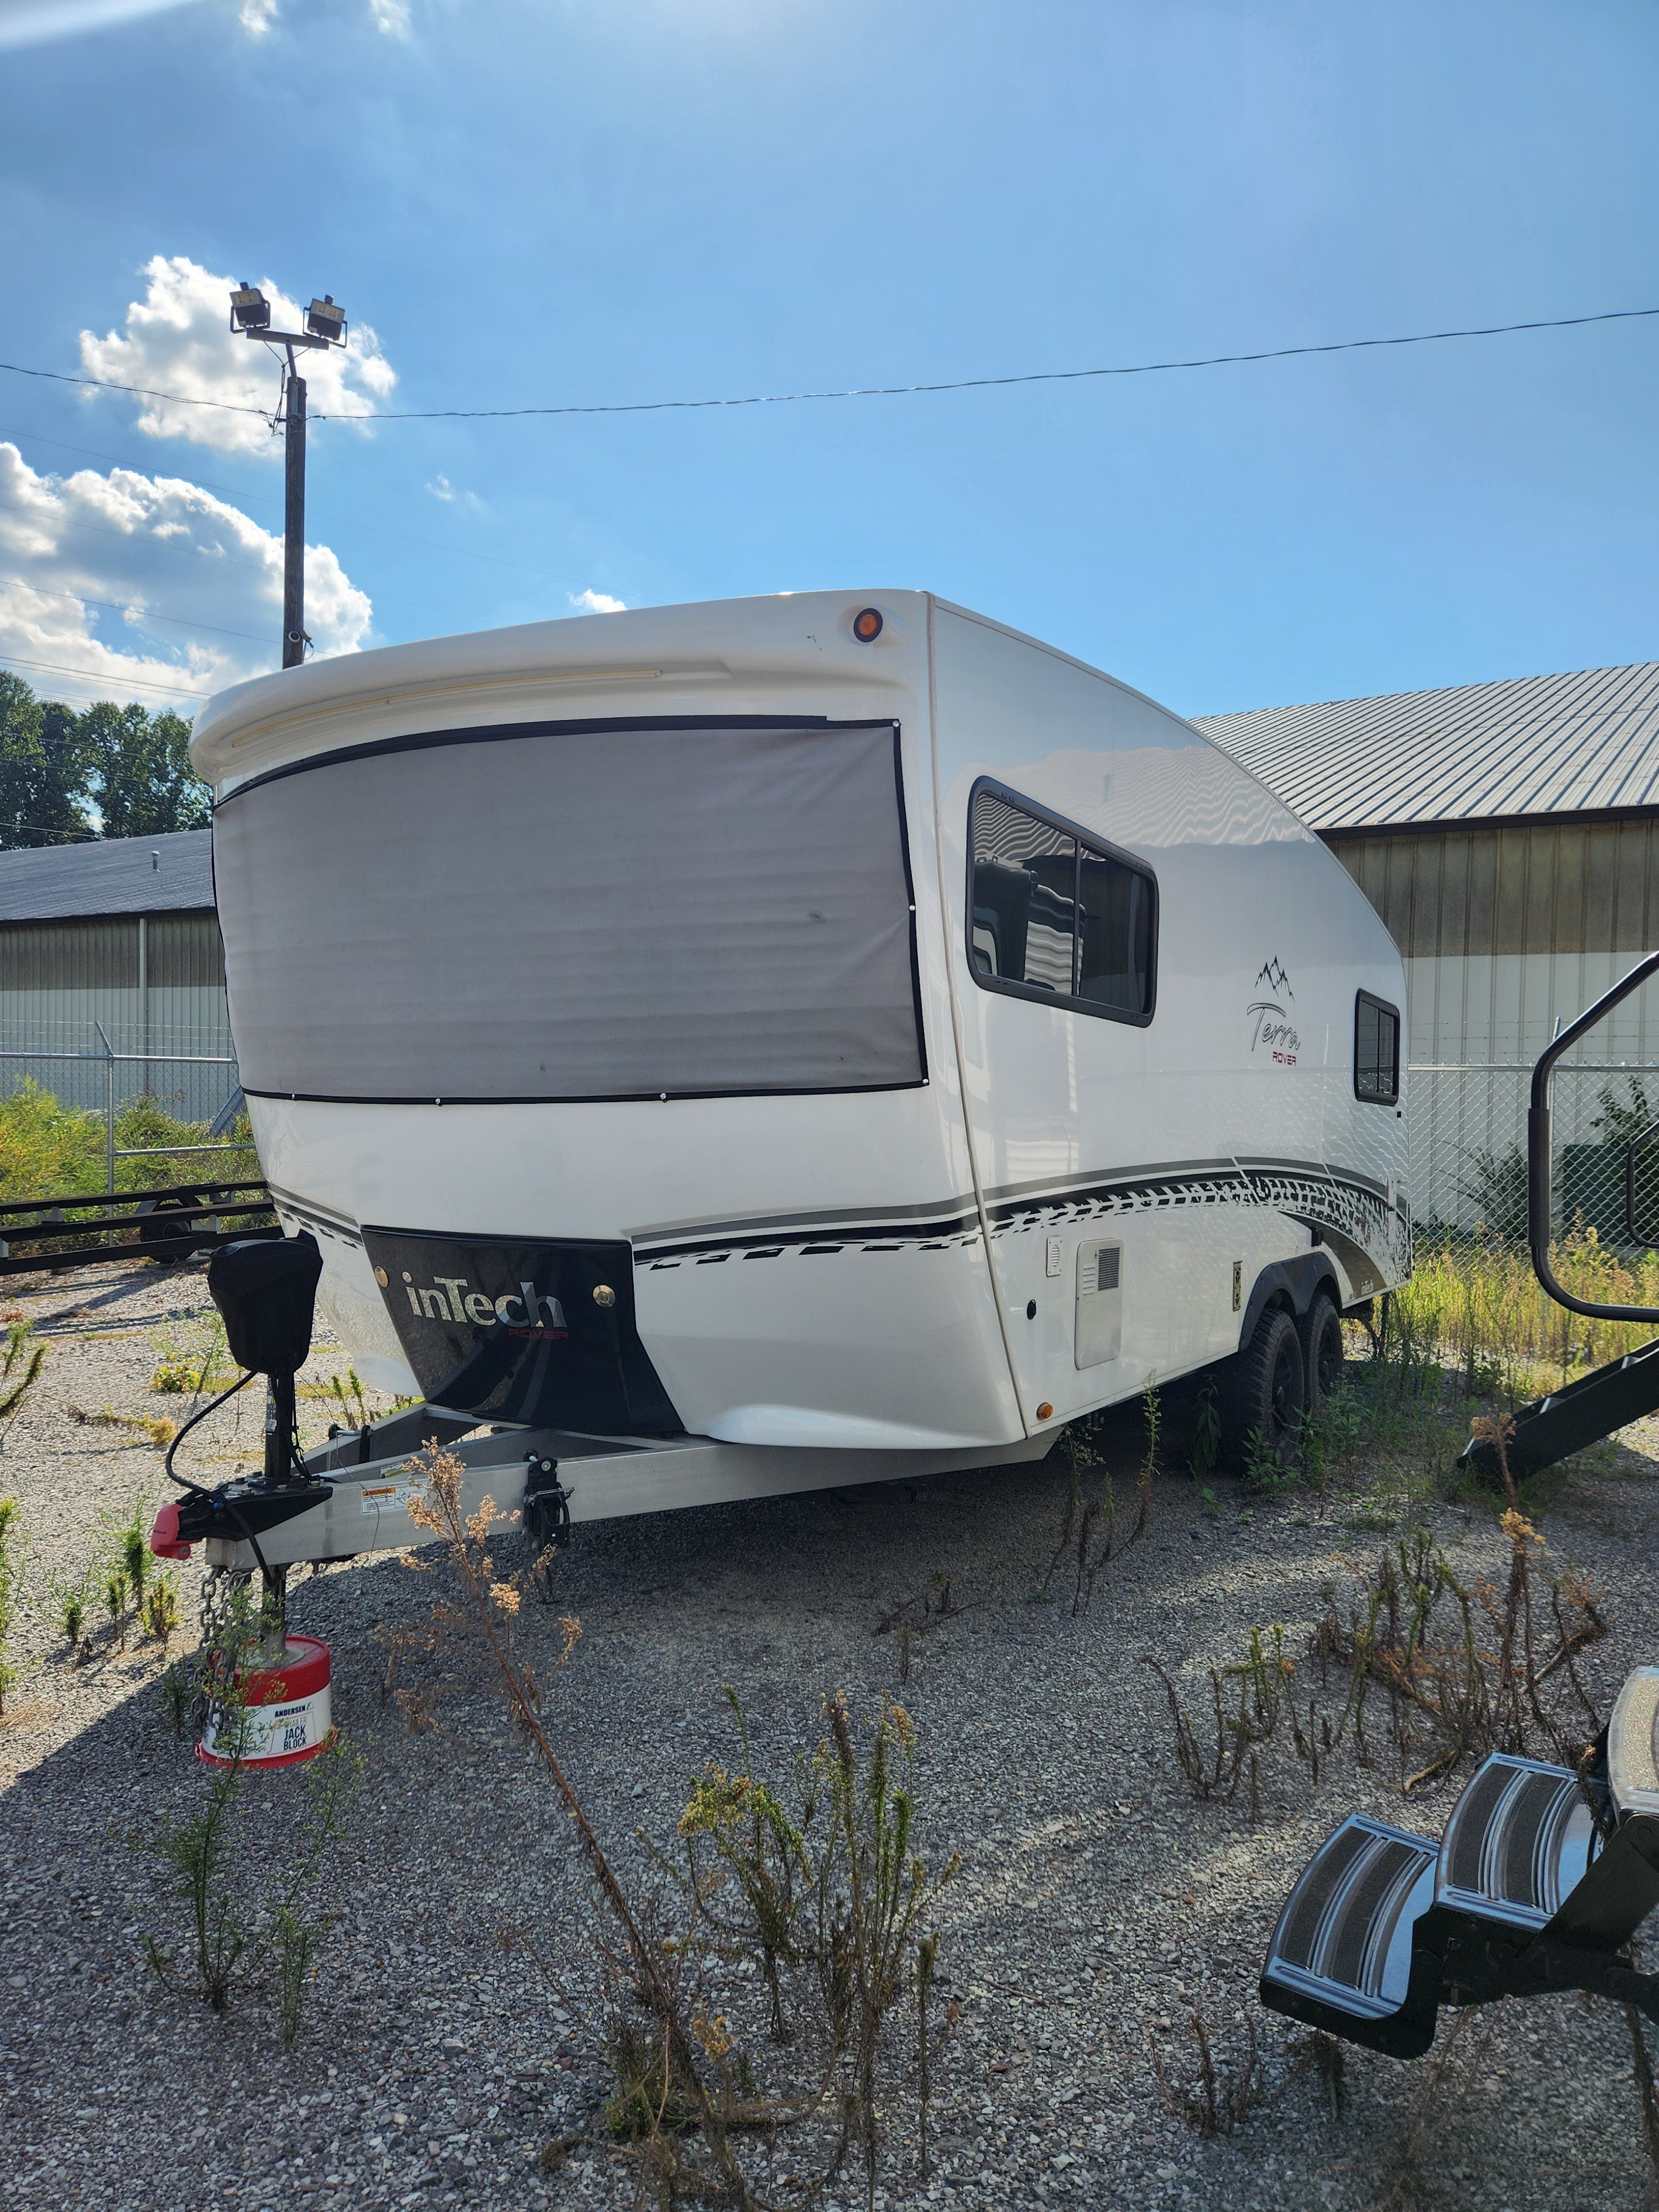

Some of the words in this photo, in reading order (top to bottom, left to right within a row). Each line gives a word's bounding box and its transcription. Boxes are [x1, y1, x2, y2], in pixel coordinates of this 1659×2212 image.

[1246, 1003, 1301, 1051] Terra
[1272, 1051, 1297, 1066] ROVER
[401, 1271, 567, 1328] inTech
[508, 1328, 569, 1340] ROVER
[274, 1705, 306, 1718] ANDERSEN
[284, 1724, 306, 1741] JACK
[284, 1735, 307, 1751] BLOCK
